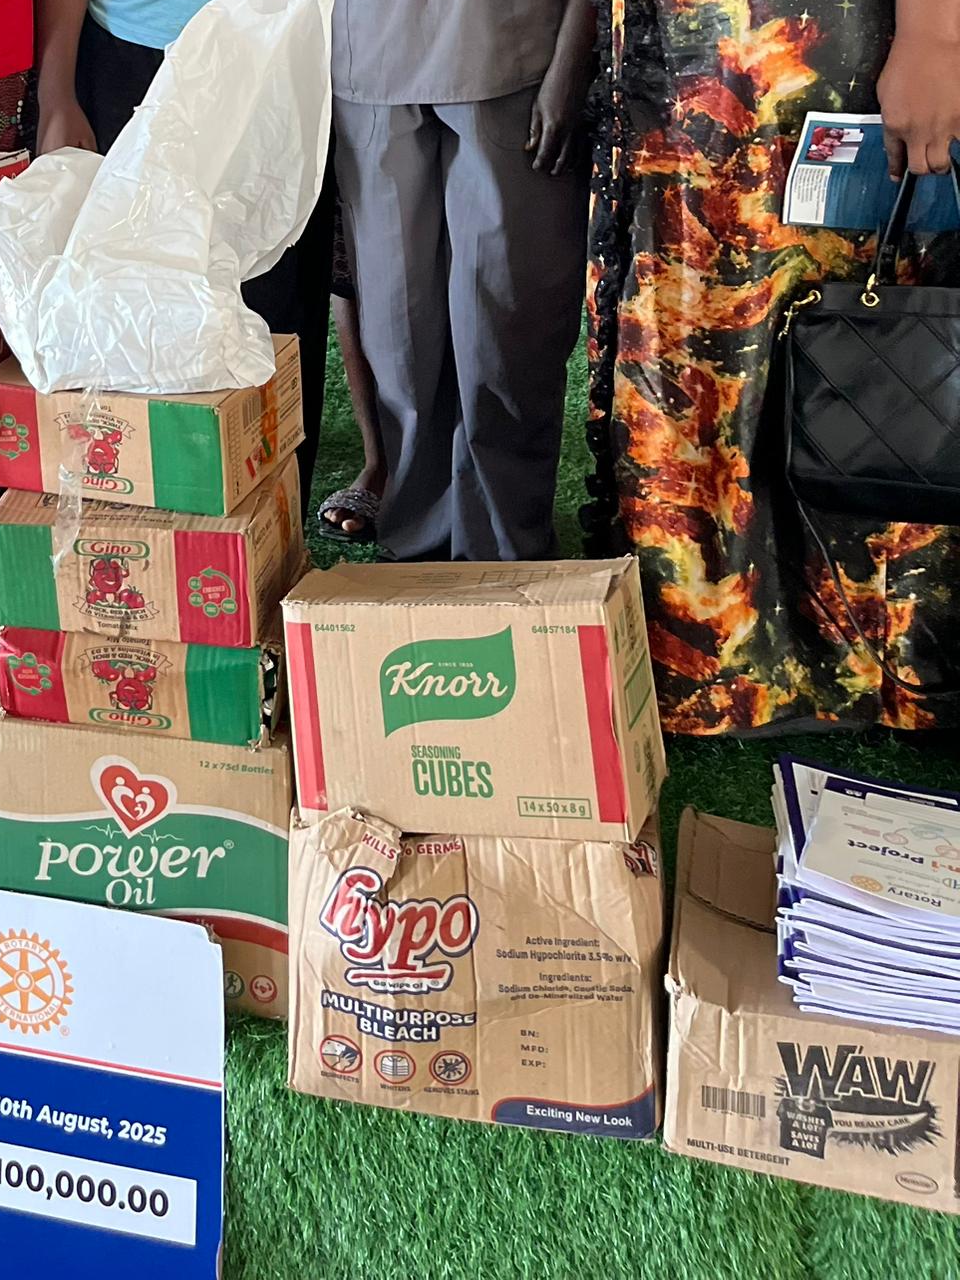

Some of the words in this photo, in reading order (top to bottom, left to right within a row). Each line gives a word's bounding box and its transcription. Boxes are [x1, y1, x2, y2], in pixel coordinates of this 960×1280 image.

[90, 541, 132, 554] Gino
[385, 661, 508, 698] Knorr
[411, 745, 461, 760] SEASONING
[199, 760, 210, 769] 12
[241, 764, 274, 775] Bottles
[412, 760, 495, 799] CUBES
[362, 832, 397, 860] KILLS
[416, 840, 461, 855] GERMS
[105, 878, 156, 906] Oil
[887, 886, 942, 907] Rotary
[4, 938, 43, 955] ROTARY
[526, 936, 553, 946] Active
[496, 949, 528, 959] Sodium
[530, 950, 586, 962] Hypochlorite
[539, 972, 592, 984] Ingredients:
[498, 984, 531, 993] Sodium
[323, 992, 475, 1026] MULTIPURPOSE
[360, 1018, 437, 1040] BLEACH
[776, 1040, 937, 1107] WAW
[36, 1102, 115, 1140] August,
[117, 1119, 168, 1146] 2025
[526, 1104, 573, 1123] Exciting
[576, 1108, 604, 1124] New
[606, 1111, 633, 1127] Look
[786, 1110, 826, 1127] WASHES
[855, 1119, 886, 1129] REALLY
[791, 1131, 820, 1143] SAVES
[687, 1137, 735, 1155] MULTI-USE
[737, 1148, 790, 1166] DETERGENT
